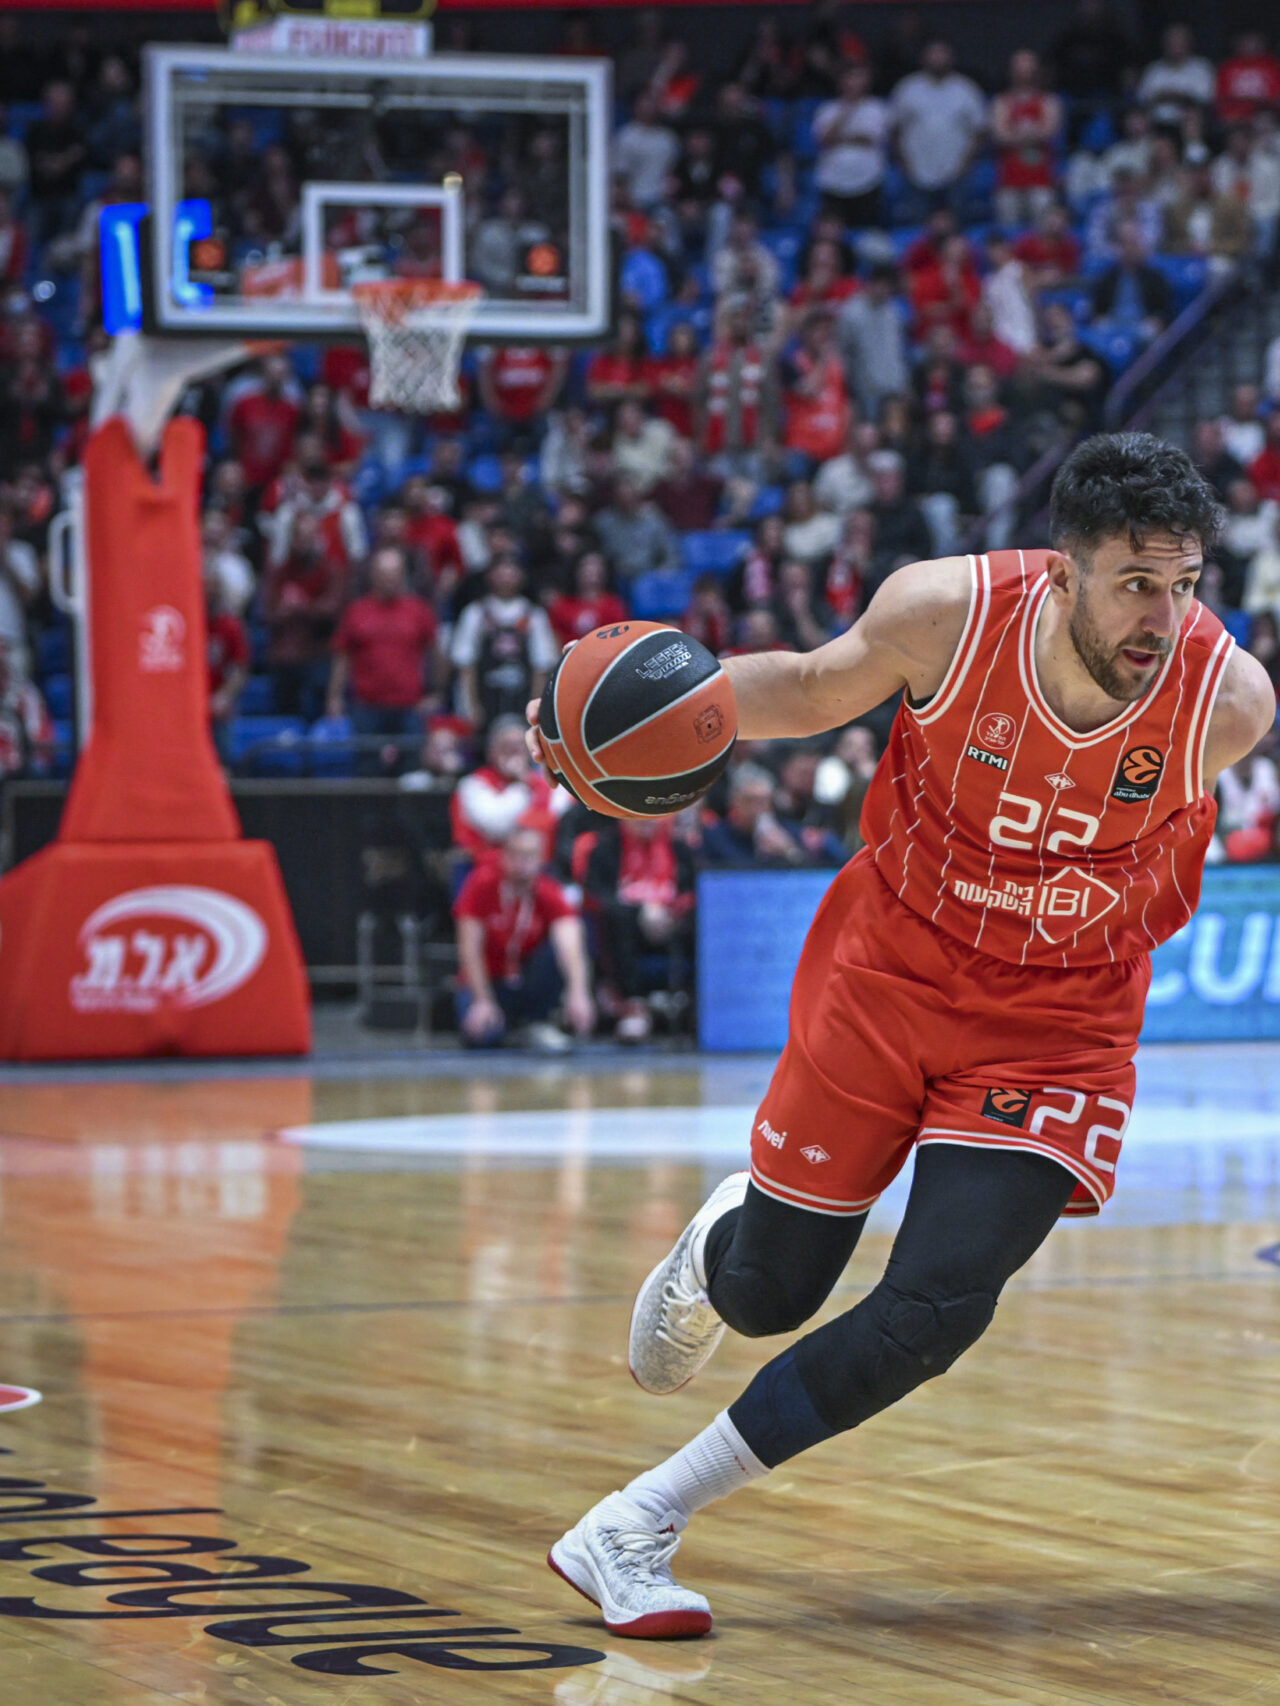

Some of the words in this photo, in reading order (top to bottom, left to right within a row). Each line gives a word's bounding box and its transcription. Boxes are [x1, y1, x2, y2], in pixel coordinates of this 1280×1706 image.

[967, 745, 1008, 770] RTMI
[989, 791, 1100, 853] 22
[954, 880, 1032, 916] השקעות
[1004, 880, 1034, 901] בית
[1037, 886, 1091, 918] IBI
[1029, 1086, 1131, 1174] 22
[0, 1474, 608, 1676] league
